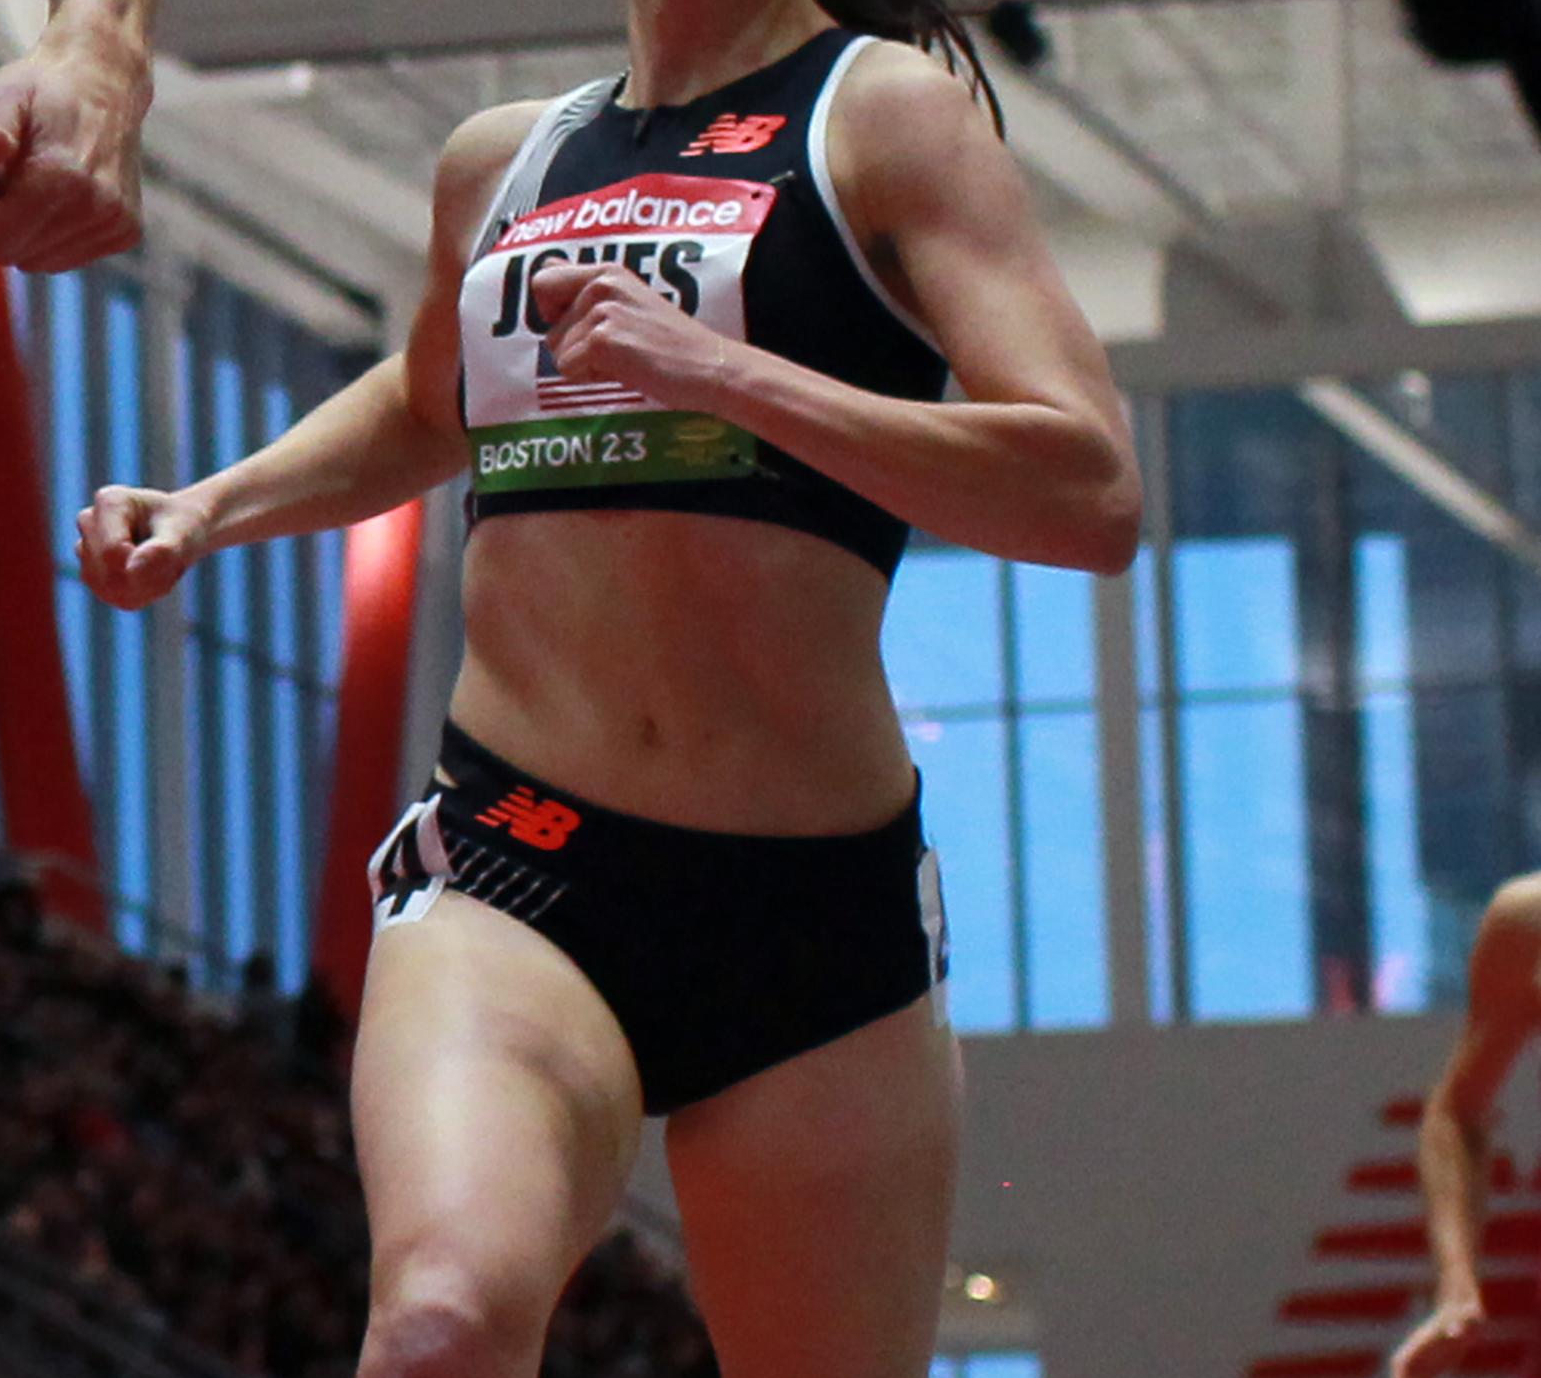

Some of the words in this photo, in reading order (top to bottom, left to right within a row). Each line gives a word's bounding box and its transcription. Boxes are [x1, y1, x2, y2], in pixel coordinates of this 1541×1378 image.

[502, 208, 574, 245] new
[572, 189, 742, 230] balance
[479, 436, 593, 474] BOSTON
[602, 432, 647, 463] 23
